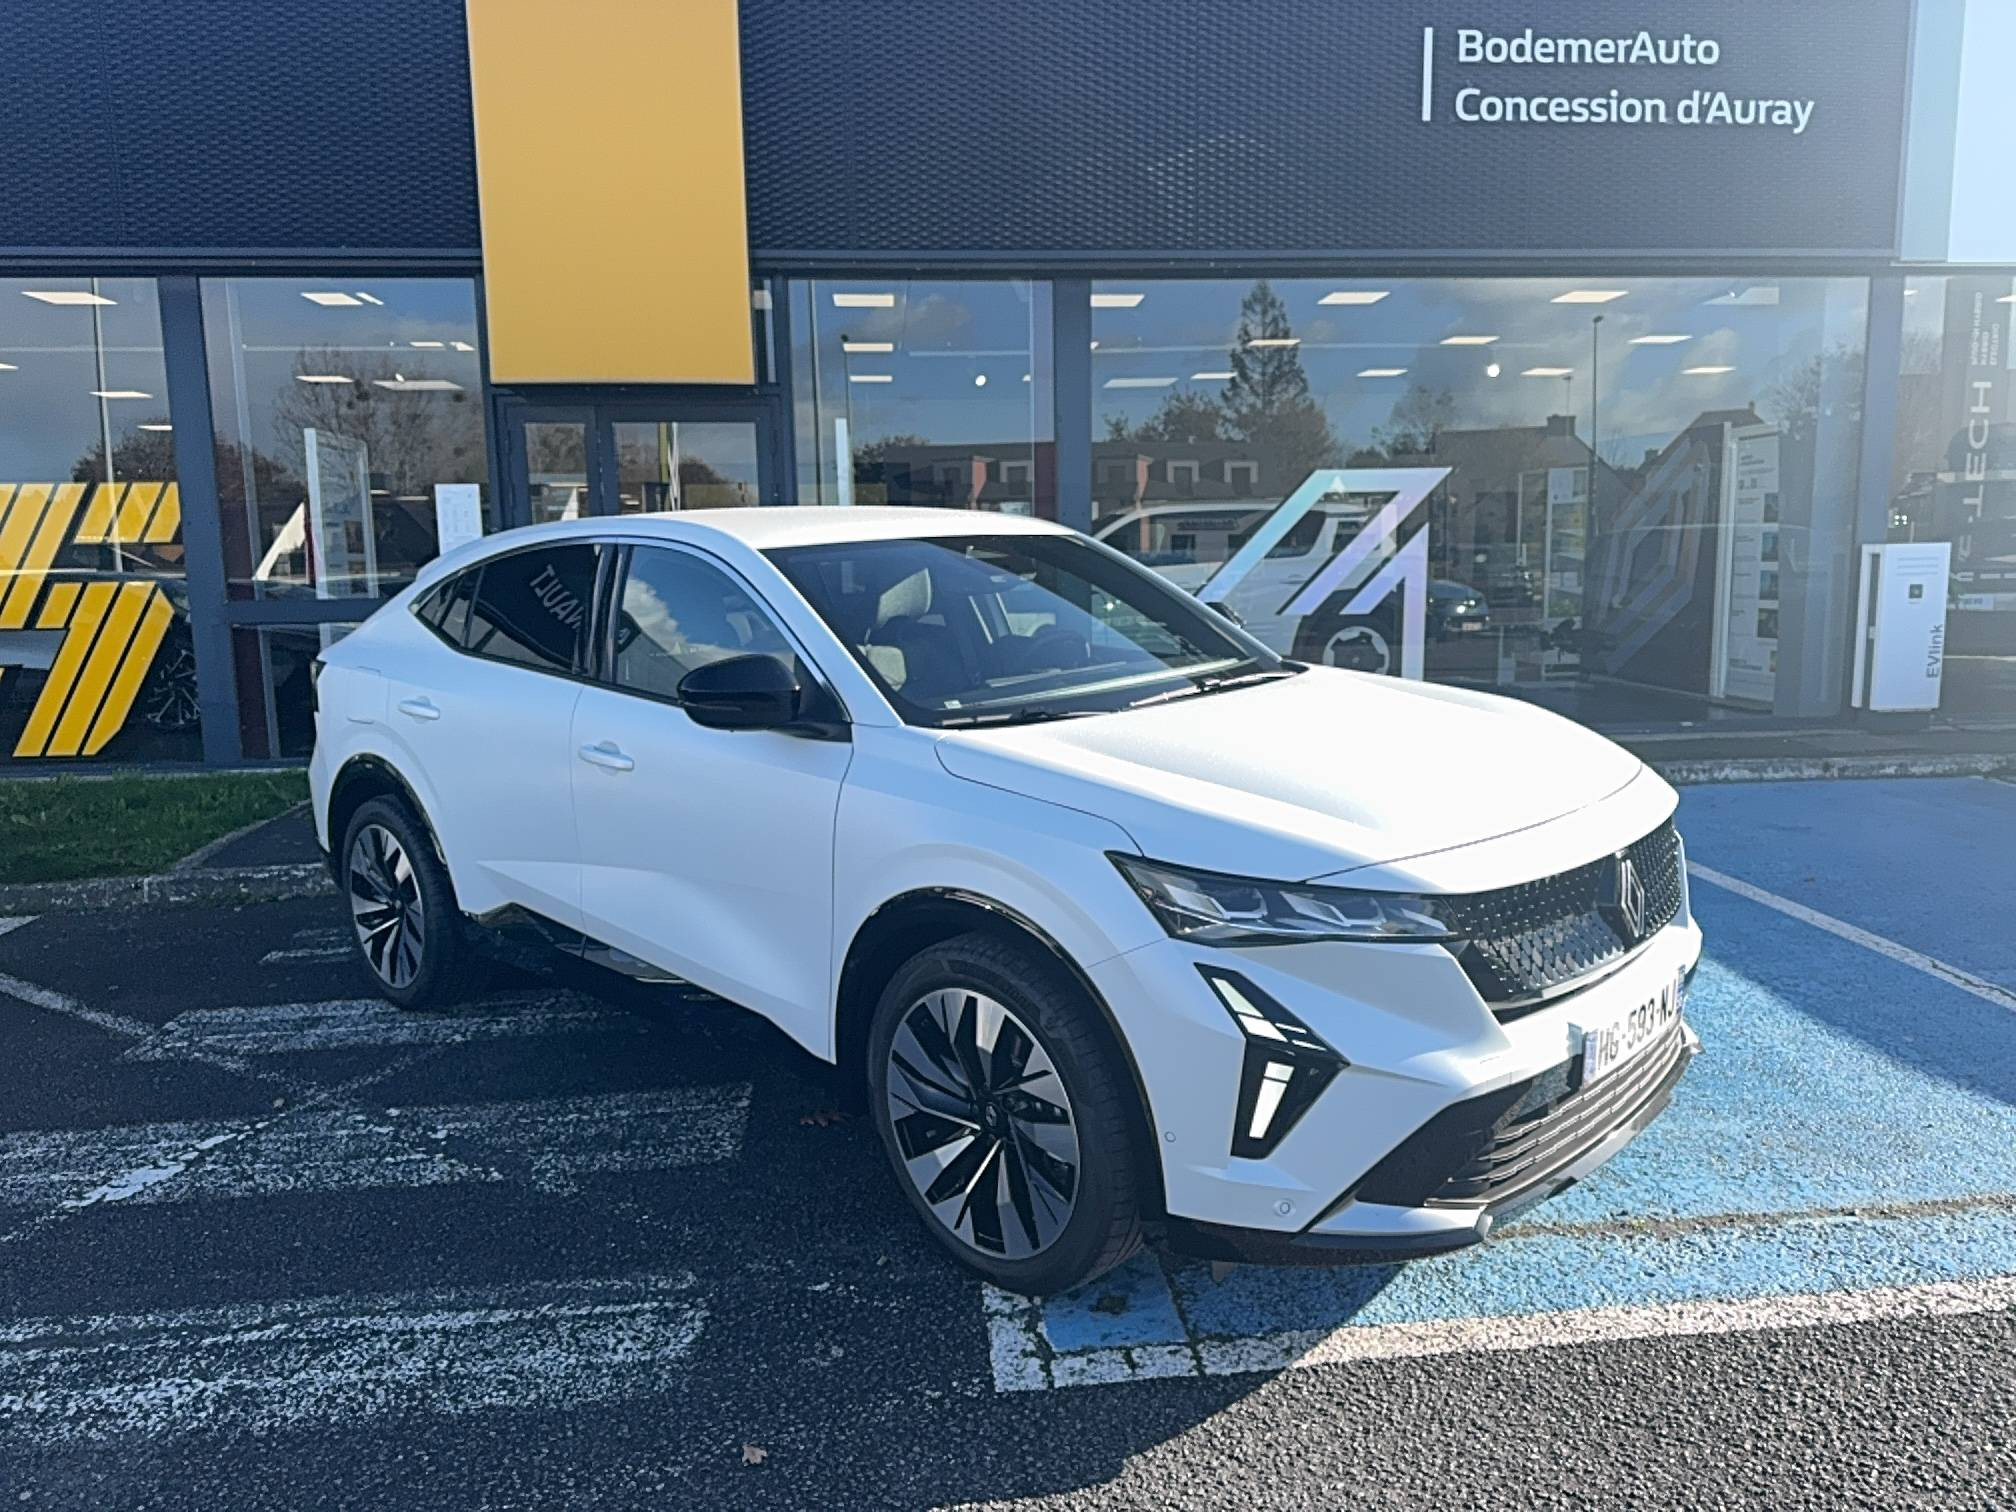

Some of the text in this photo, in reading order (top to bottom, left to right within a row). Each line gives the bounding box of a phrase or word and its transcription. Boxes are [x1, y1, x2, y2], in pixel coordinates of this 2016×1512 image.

[1456, 28, 1721, 66] BodemerAuto
[1454, 87, 1815, 134] Concession d'Auray
[1926, 624, 1943, 679] EVlink
